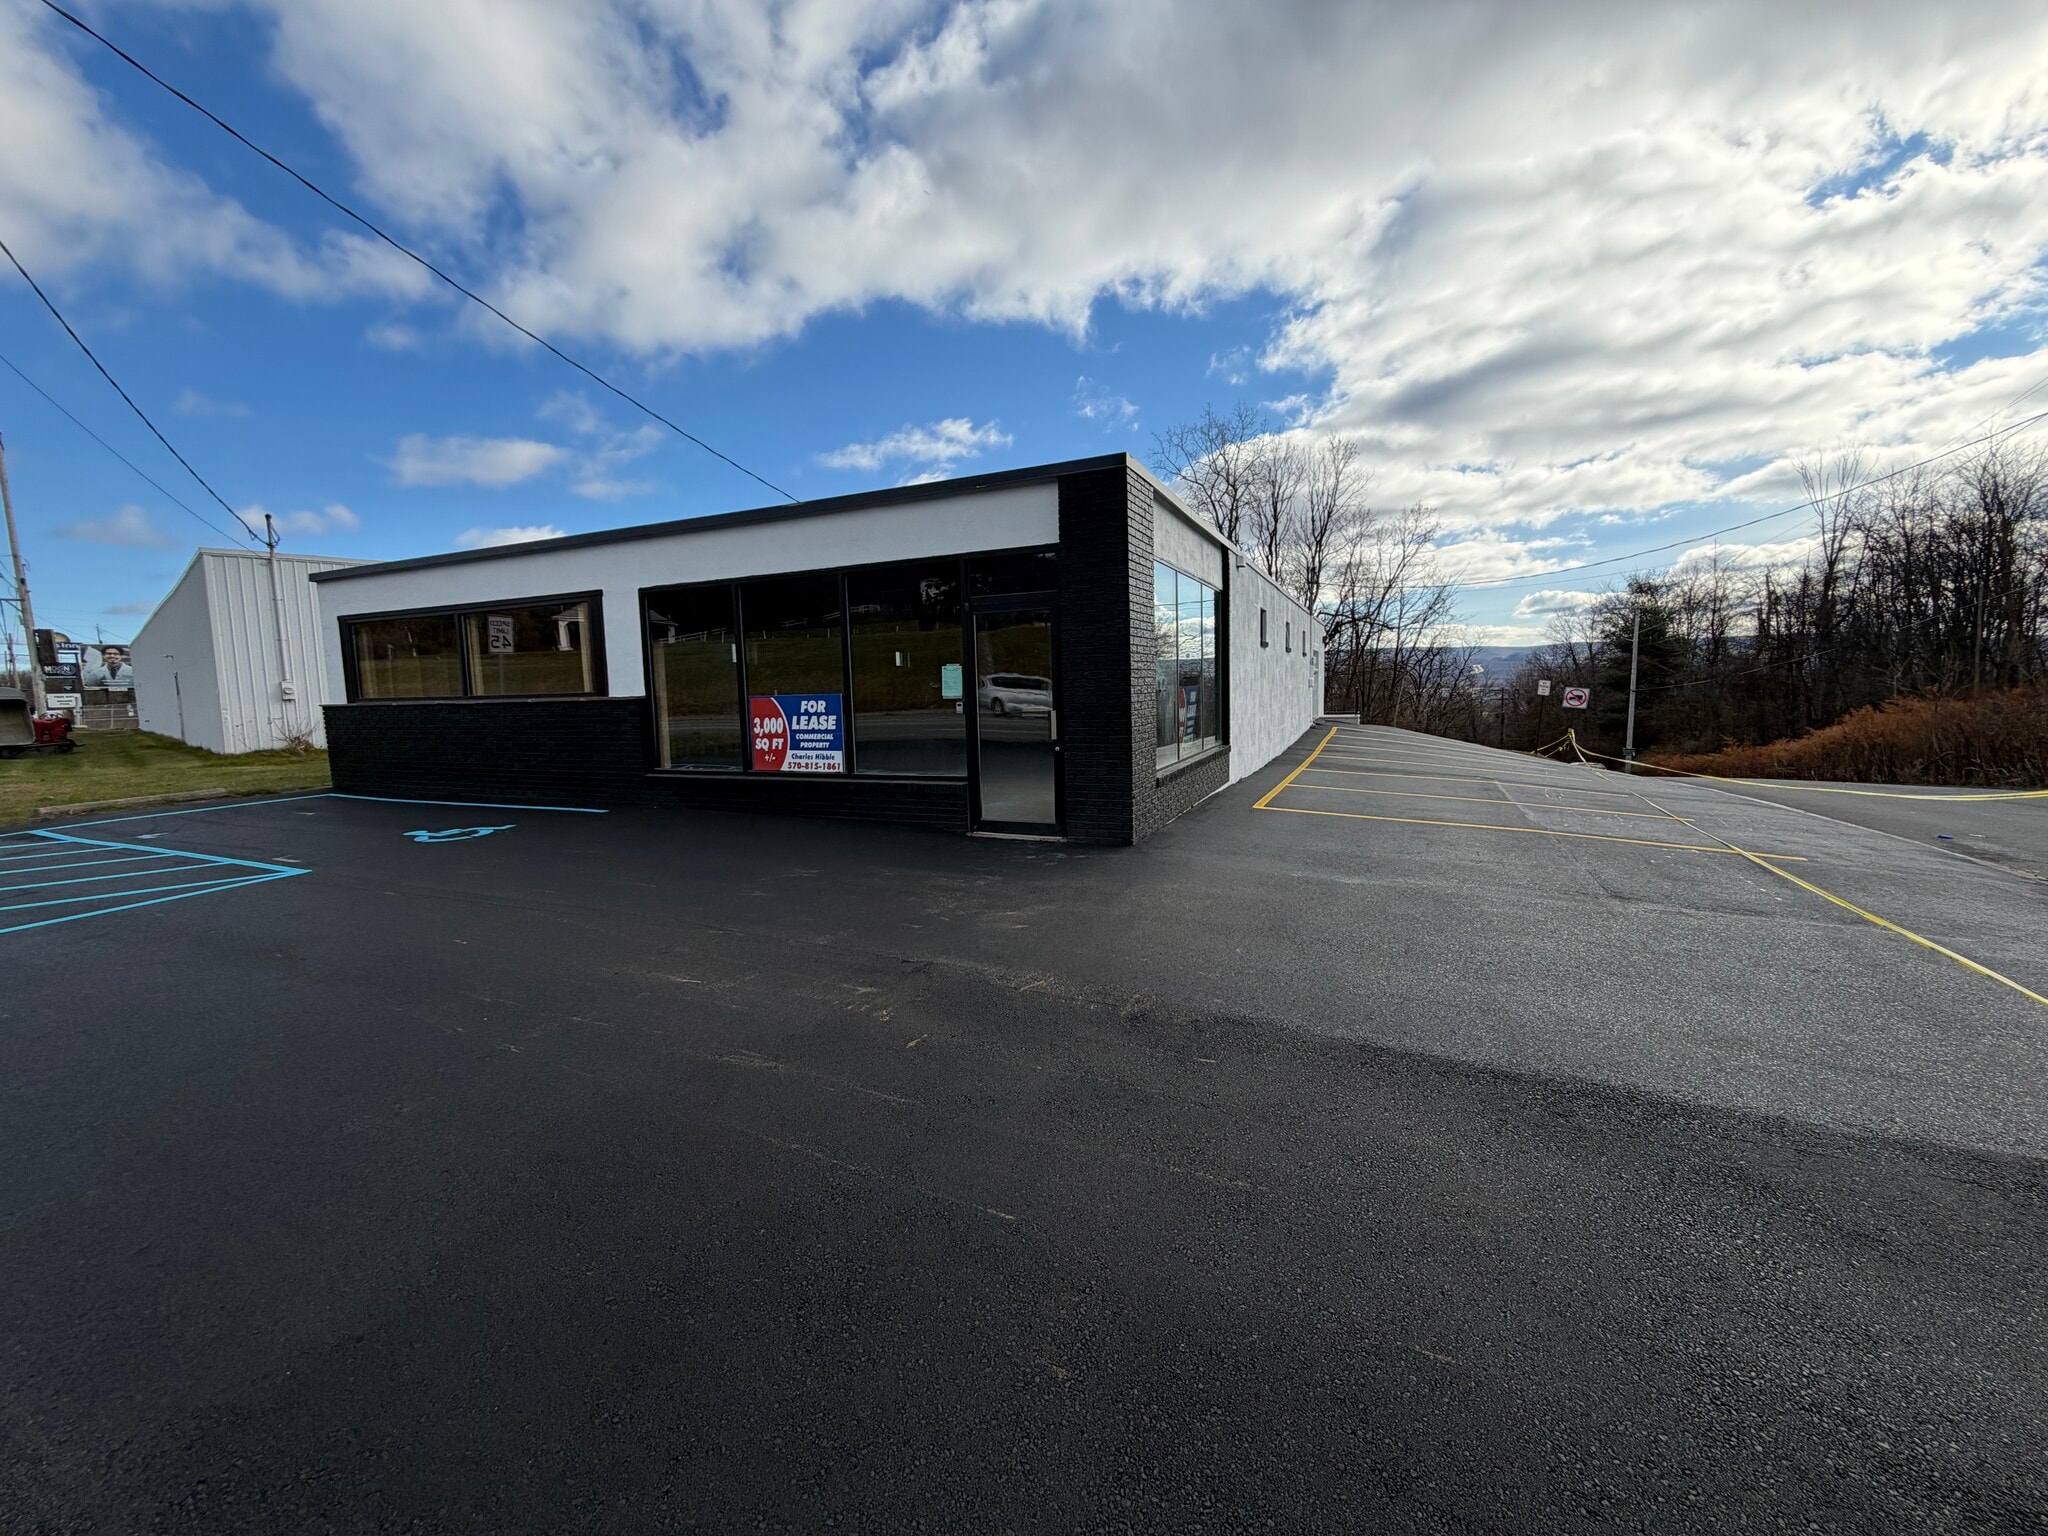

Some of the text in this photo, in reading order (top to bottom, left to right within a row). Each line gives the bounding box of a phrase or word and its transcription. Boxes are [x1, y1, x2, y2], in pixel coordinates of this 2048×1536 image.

[800, 700, 826, 713] FOR
[753, 717, 784, 736] 3,000
[792, 715, 837, 730] LEASE
[755, 738, 784, 751] SQ FT
[787, 762, 841, 770] 570-815-1861
